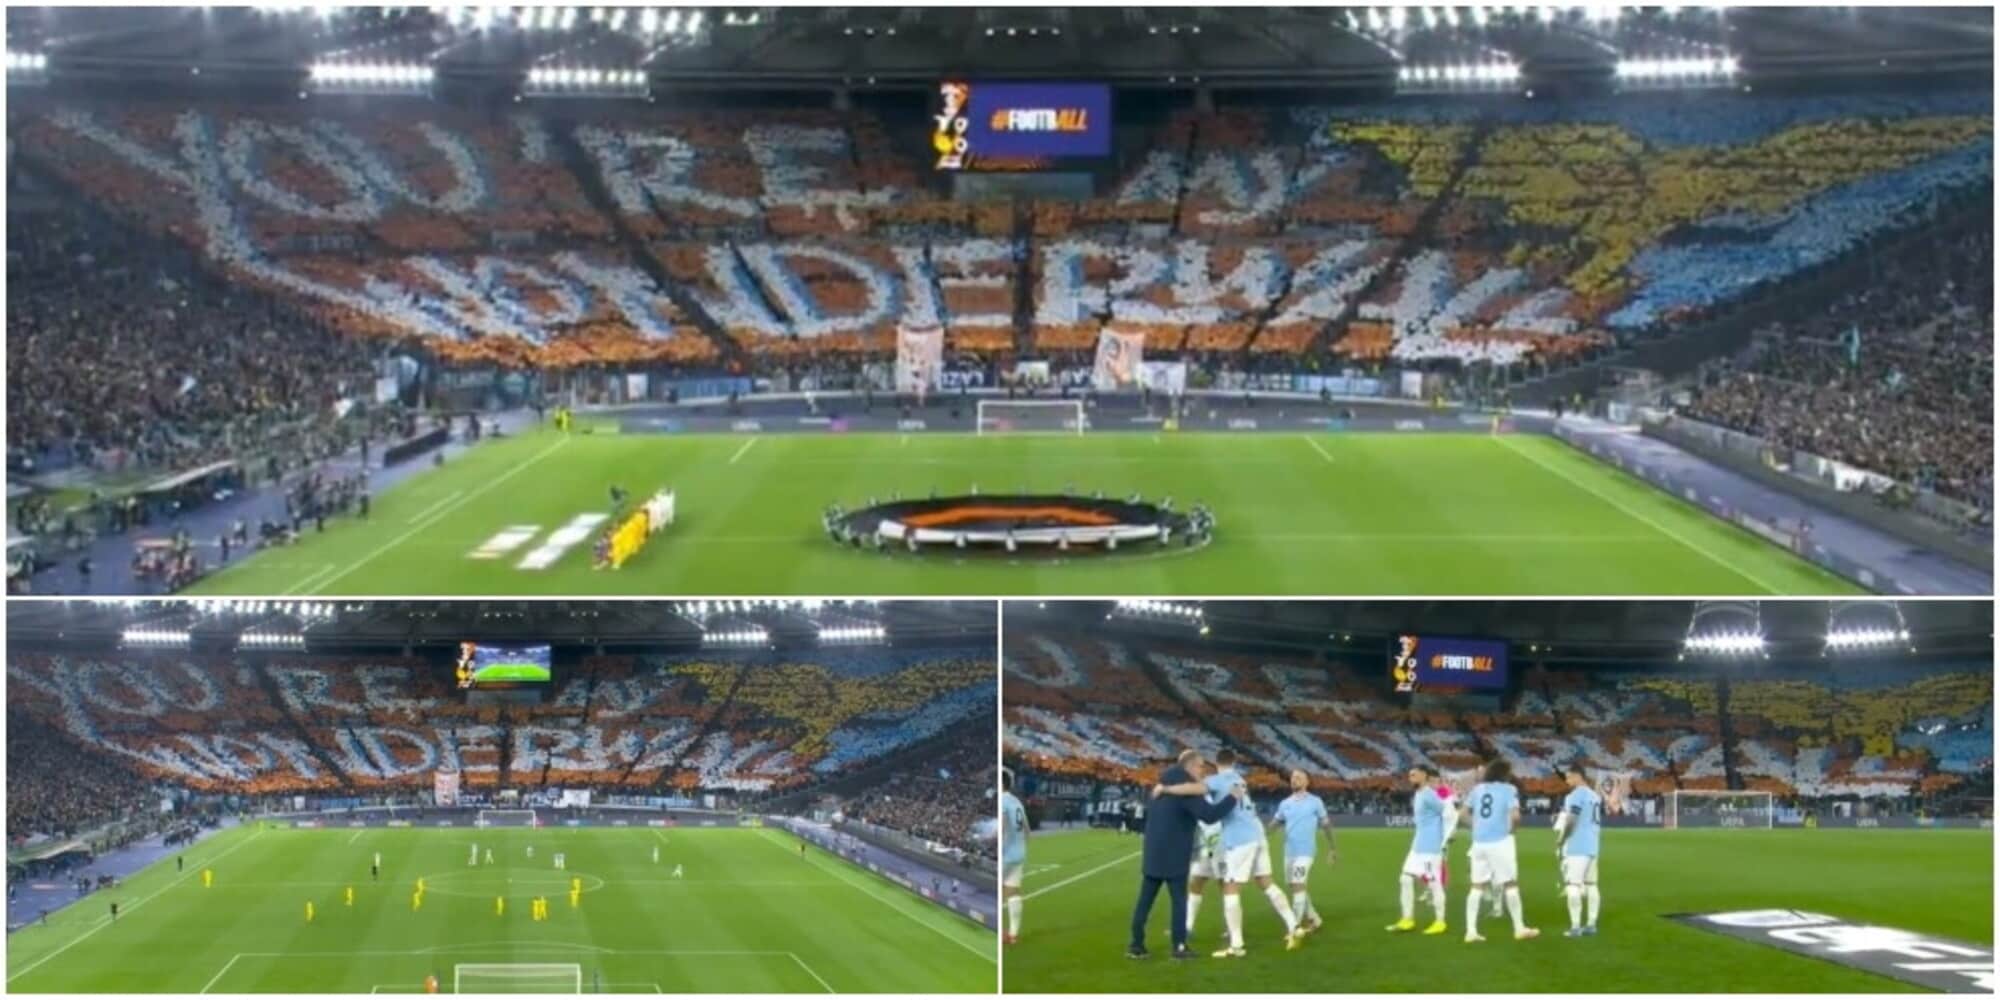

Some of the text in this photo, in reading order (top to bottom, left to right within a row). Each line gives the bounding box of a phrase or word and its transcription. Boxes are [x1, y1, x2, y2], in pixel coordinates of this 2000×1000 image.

[991, 108, 1087, 130] #FOOTBALL
[48, 108, 895, 270] YOU'RE
[1431, 654, 1493, 671] #FOOTBALL
[1479, 793, 1494, 819] 8
